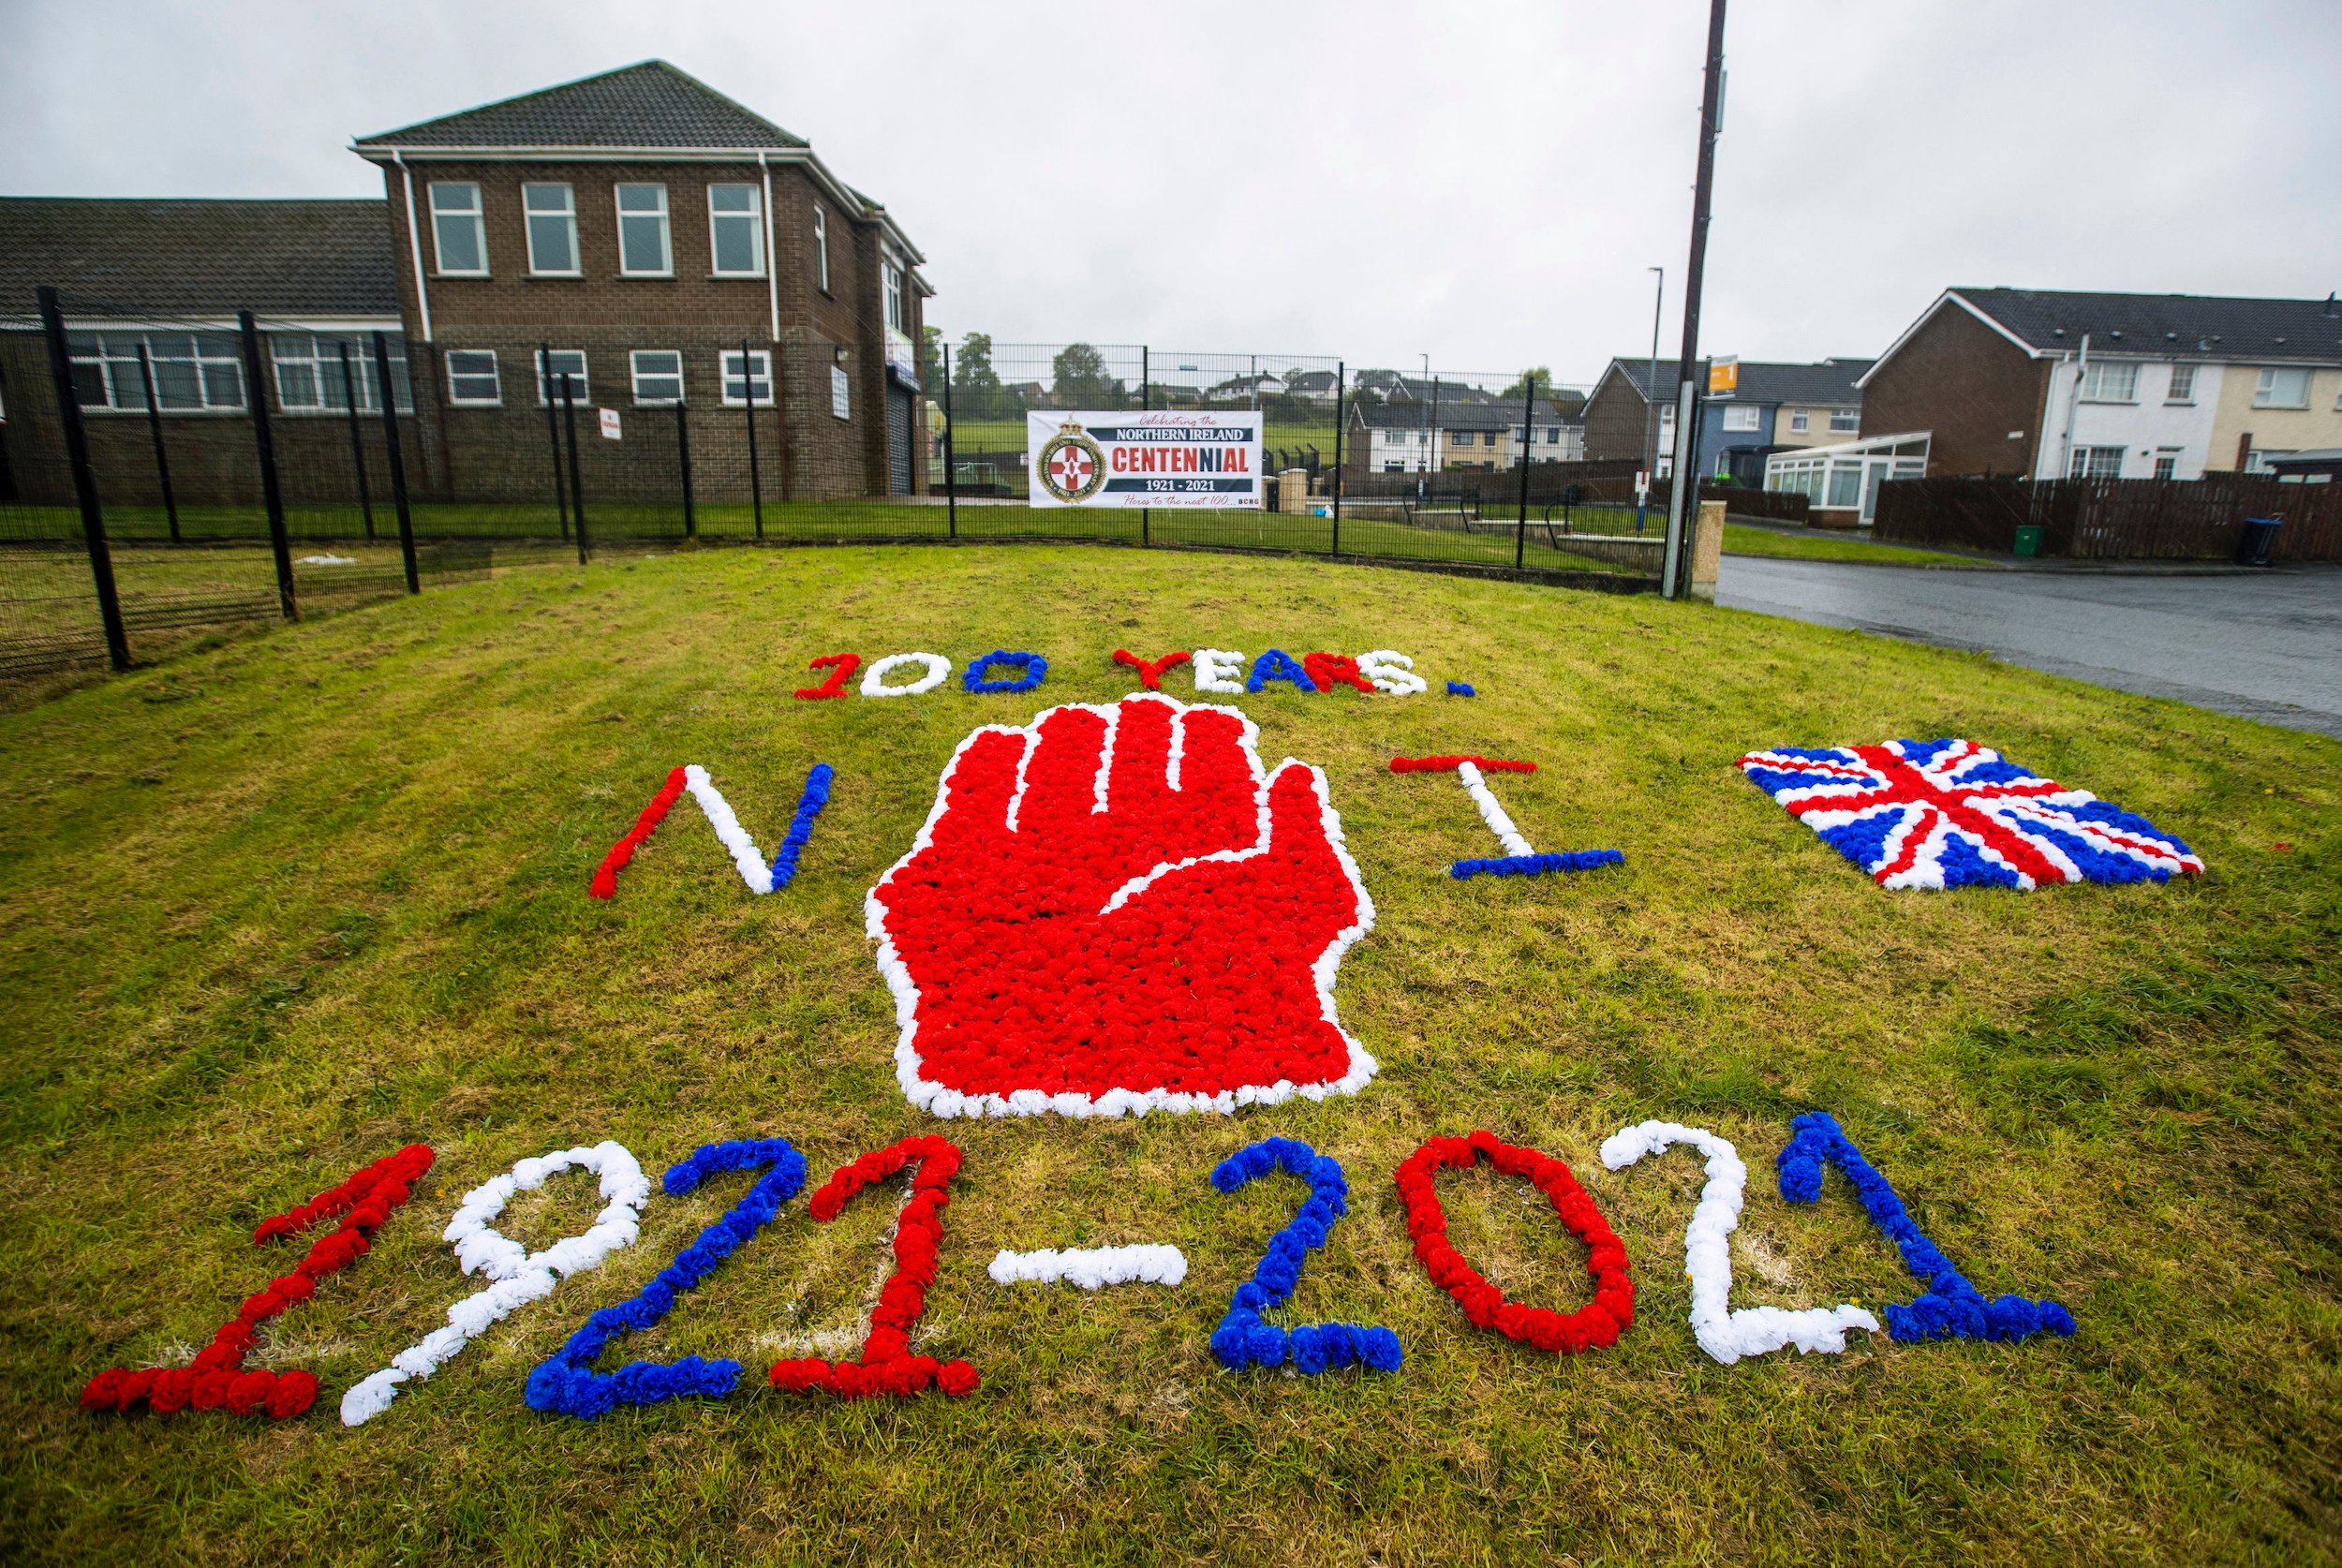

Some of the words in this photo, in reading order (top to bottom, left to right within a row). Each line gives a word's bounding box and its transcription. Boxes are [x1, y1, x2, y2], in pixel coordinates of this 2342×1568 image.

[1139, 413, 1197, 427] Celebrating
[1198, 414, 1217, 425] the
[1116, 428, 1187, 441] NORTHERN
[1189, 428, 1244, 441] IRELAND
[1111, 447, 1249, 473] CENTENNIAL
[1146, 480, 1175, 492] 1921
[1185, 480, 1215, 492] 2021
[1124, 494, 1149, 506] Heres
[1151, 496, 1163, 505] to
[1164, 495, 1181, 505] the
[1184, 496, 1208, 505] next
[793, 648, 1048, 699] 100
[589, 762, 834, 899] N
[1389, 754, 1624, 880] I
